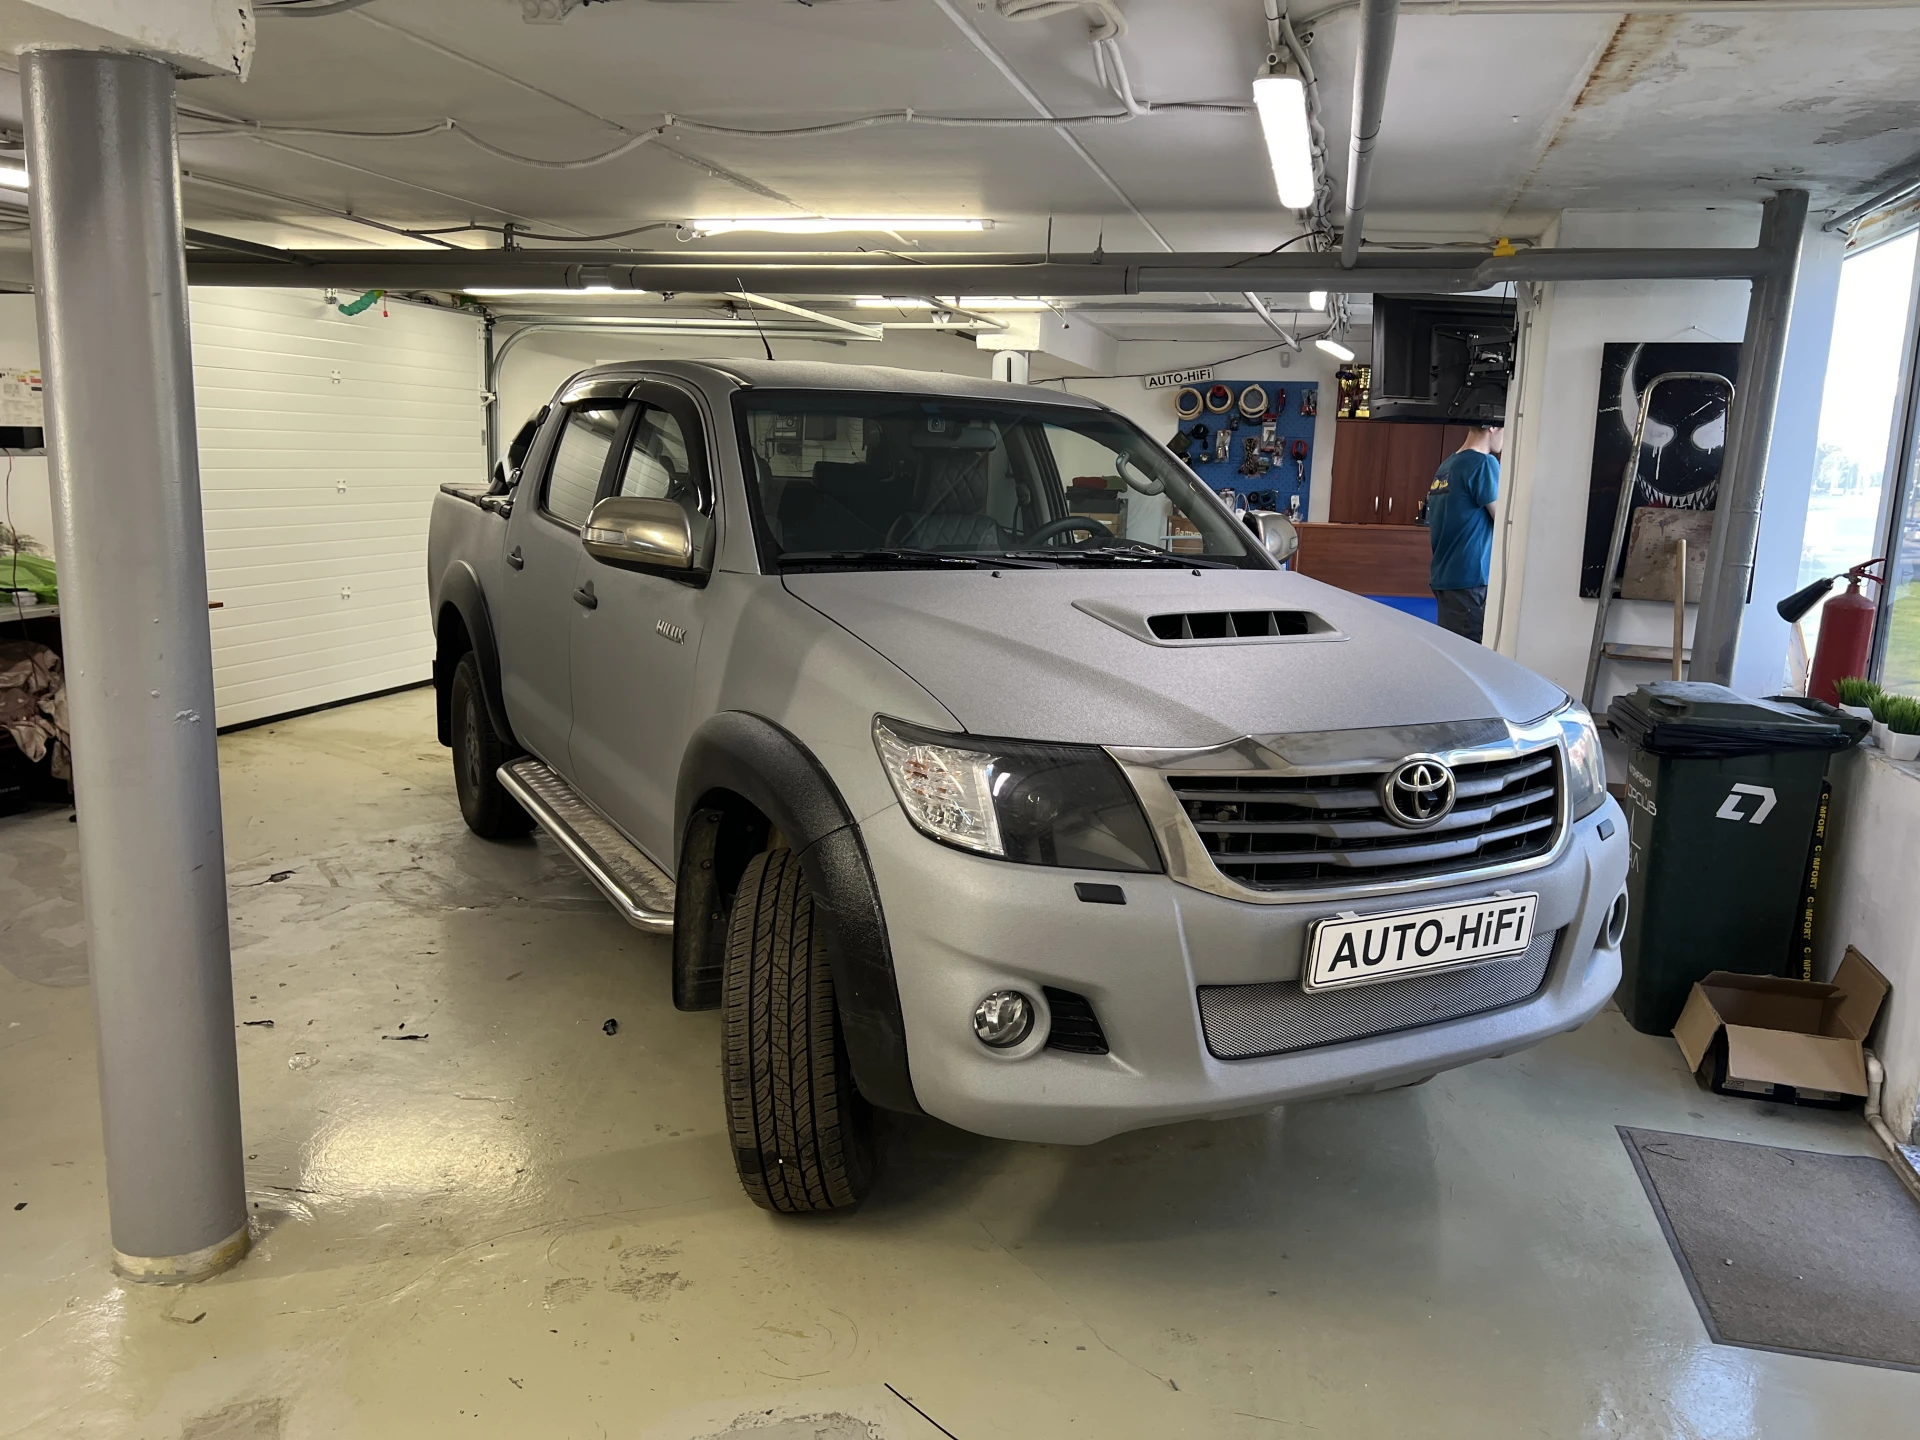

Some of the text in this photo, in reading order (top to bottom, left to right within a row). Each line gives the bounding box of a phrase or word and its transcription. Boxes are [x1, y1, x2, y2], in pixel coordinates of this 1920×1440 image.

[1148, 368, 1211, 388] AUTO-HiFi
[656, 619, 687, 645] HILUX
[1816, 793, 1829, 838] CMFORT
[1810, 845, 1822, 889] CMFORT
[1327, 905, 1527, 973] AUTO-HiFi
[1803, 896, 1815, 940] CMFORT
